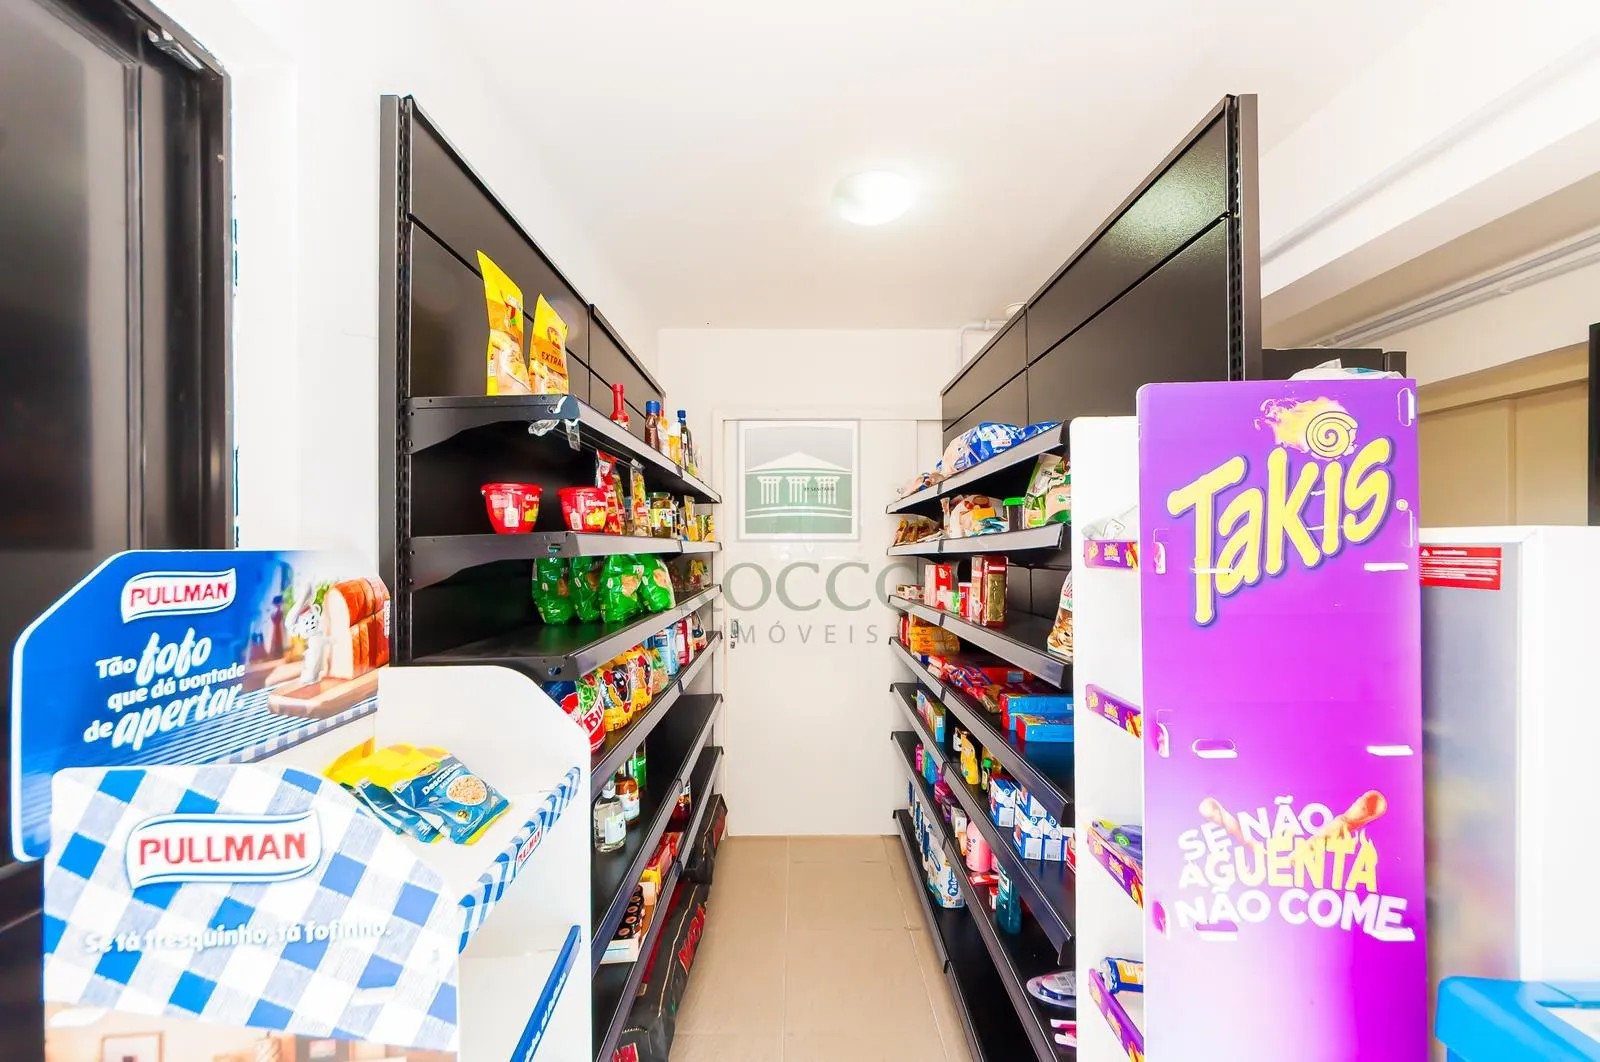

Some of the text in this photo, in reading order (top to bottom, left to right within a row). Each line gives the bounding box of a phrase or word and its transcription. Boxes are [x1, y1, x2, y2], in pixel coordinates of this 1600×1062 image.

[130, 582, 230, 607] PULLMAN
[95, 627, 212, 686] Tão fofo
[107, 662, 246, 713] que dá vontade
[83, 683, 245, 751] de apertar.
[139, 832, 307, 866] PULLMAN
[1178, 795, 1334, 861] SE NÃO
[1179, 832, 1378, 893] AGUENTA
[1174, 886, 1408, 934] NÃO COME
[84, 933, 113, 954] Se
[114, 930, 139, 953] tá
[276, 918, 301, 945] tá
